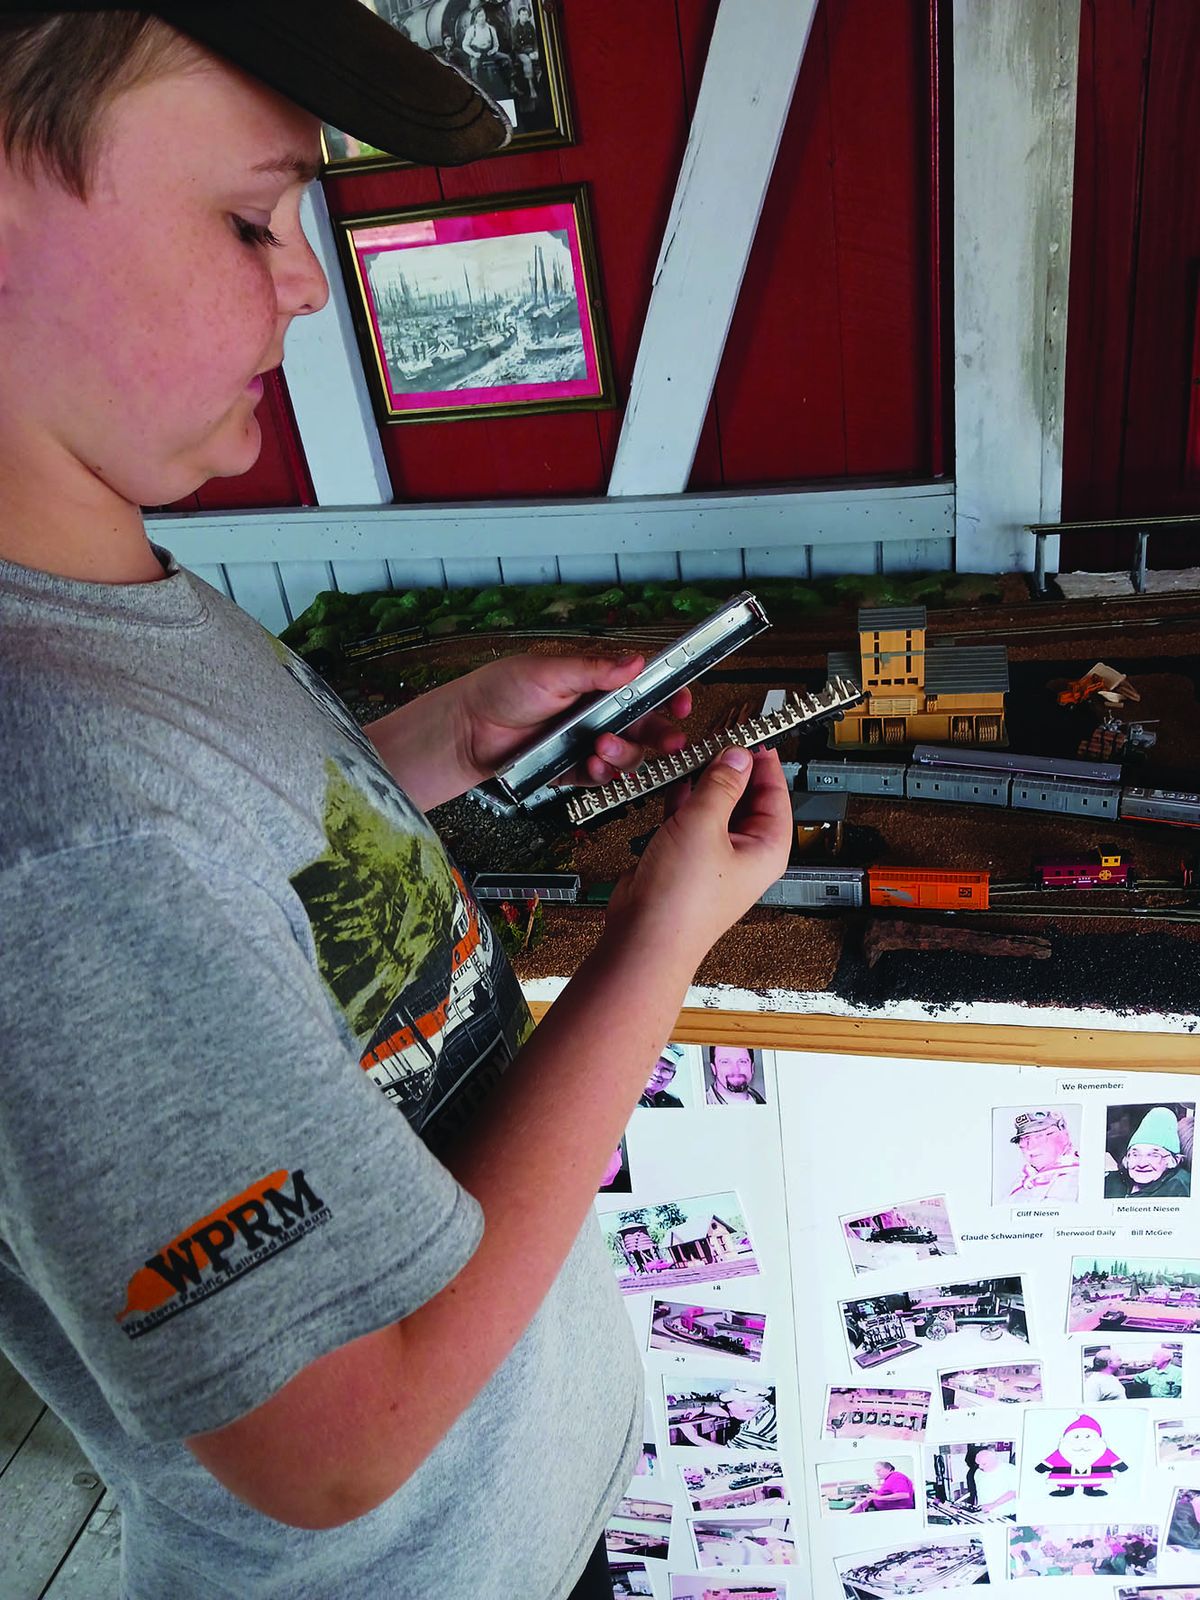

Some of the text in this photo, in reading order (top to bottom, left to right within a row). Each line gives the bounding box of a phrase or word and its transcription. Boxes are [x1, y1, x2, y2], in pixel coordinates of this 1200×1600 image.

[1077, 1082, 1124, 1090] Remember:
[1034, 1209, 1060, 1217] Niesen
[1117, 1205, 1151, 1213] Melicent
[145, 1169, 324, 1293] WPRM
[1097, 1229, 1116, 1237] Daily
[991, 1232, 1044, 1240] Schwaninger
[121, 1300, 178, 1334] Western
[179, 1275, 224, 1303] Pacific
[227, 1241, 277, 1278] Railroad
[280, 1207, 332, 1244] Museum
